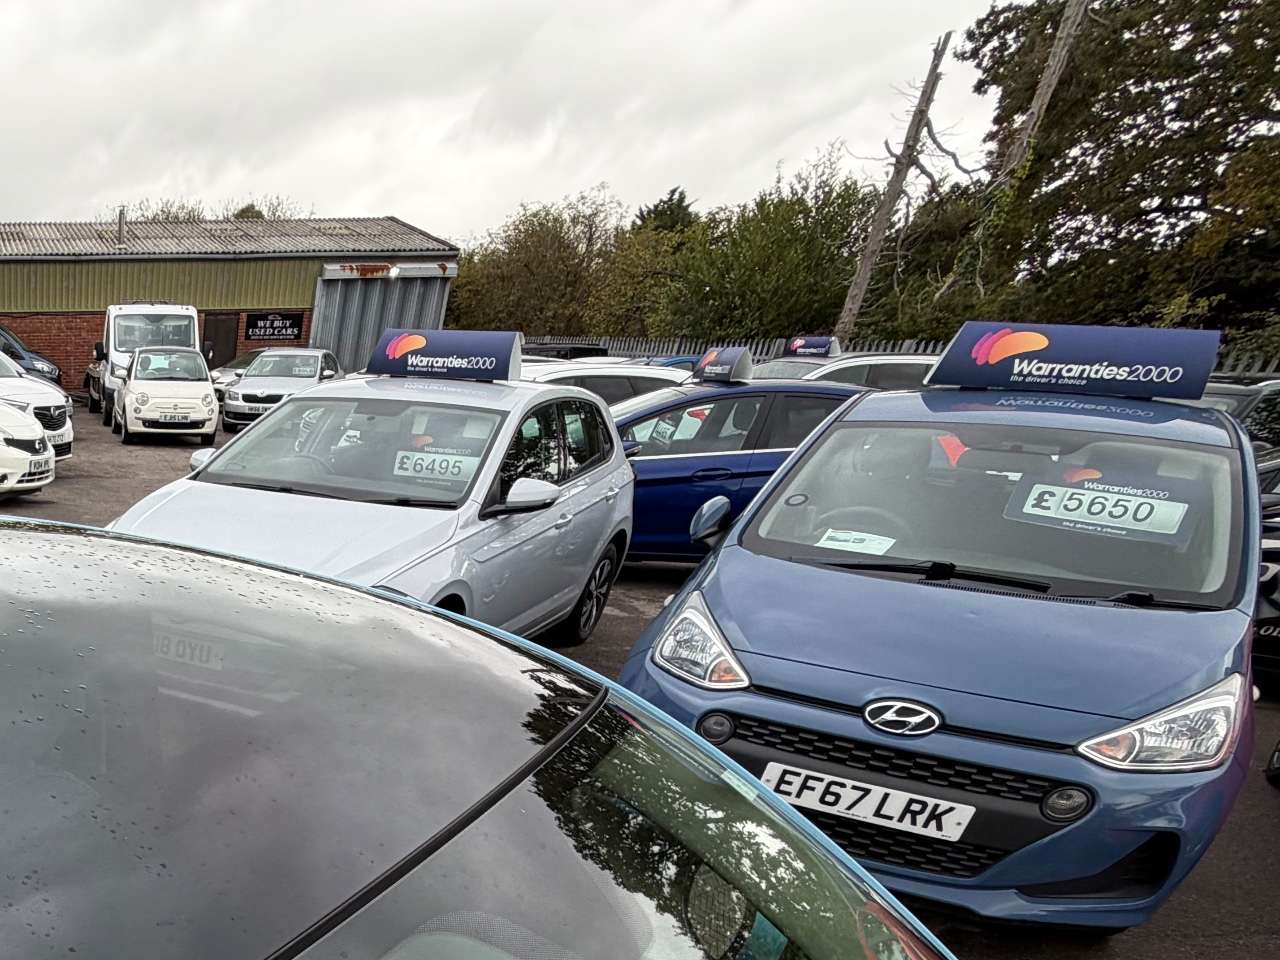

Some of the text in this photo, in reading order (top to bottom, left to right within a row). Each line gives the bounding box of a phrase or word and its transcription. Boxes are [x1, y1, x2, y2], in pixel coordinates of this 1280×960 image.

[407, 354, 496, 369] Warranties2000
[1012, 358, 1184, 383] Warranties2000
[1025, 376, 1057, 384] driver's
[1058, 377, 1087, 386] choice
[397, 455, 463, 476] £6495
[1083, 481, 1169, 499] Warranties2000
[1031, 490, 1155, 523] £5650
[774, 768, 956, 832] EF67 LRK
